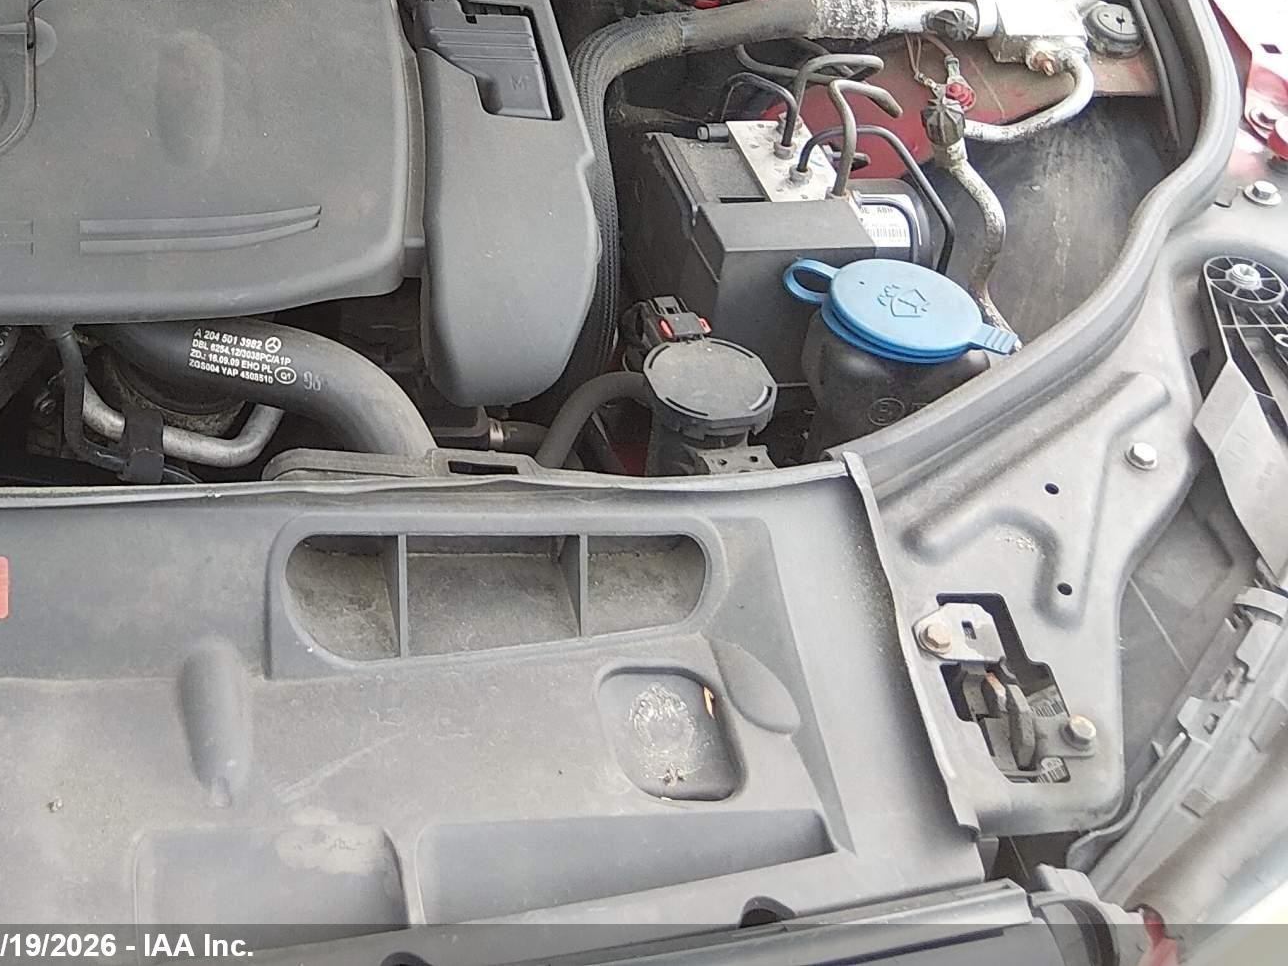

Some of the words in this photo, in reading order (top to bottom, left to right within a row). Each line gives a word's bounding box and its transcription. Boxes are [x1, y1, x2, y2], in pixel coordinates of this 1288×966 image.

[194, 328, 201, 338] A
[204, 330, 220, 341] 204
[222, 334, 237, 345] 501
[261, 364, 272, 374] PL
